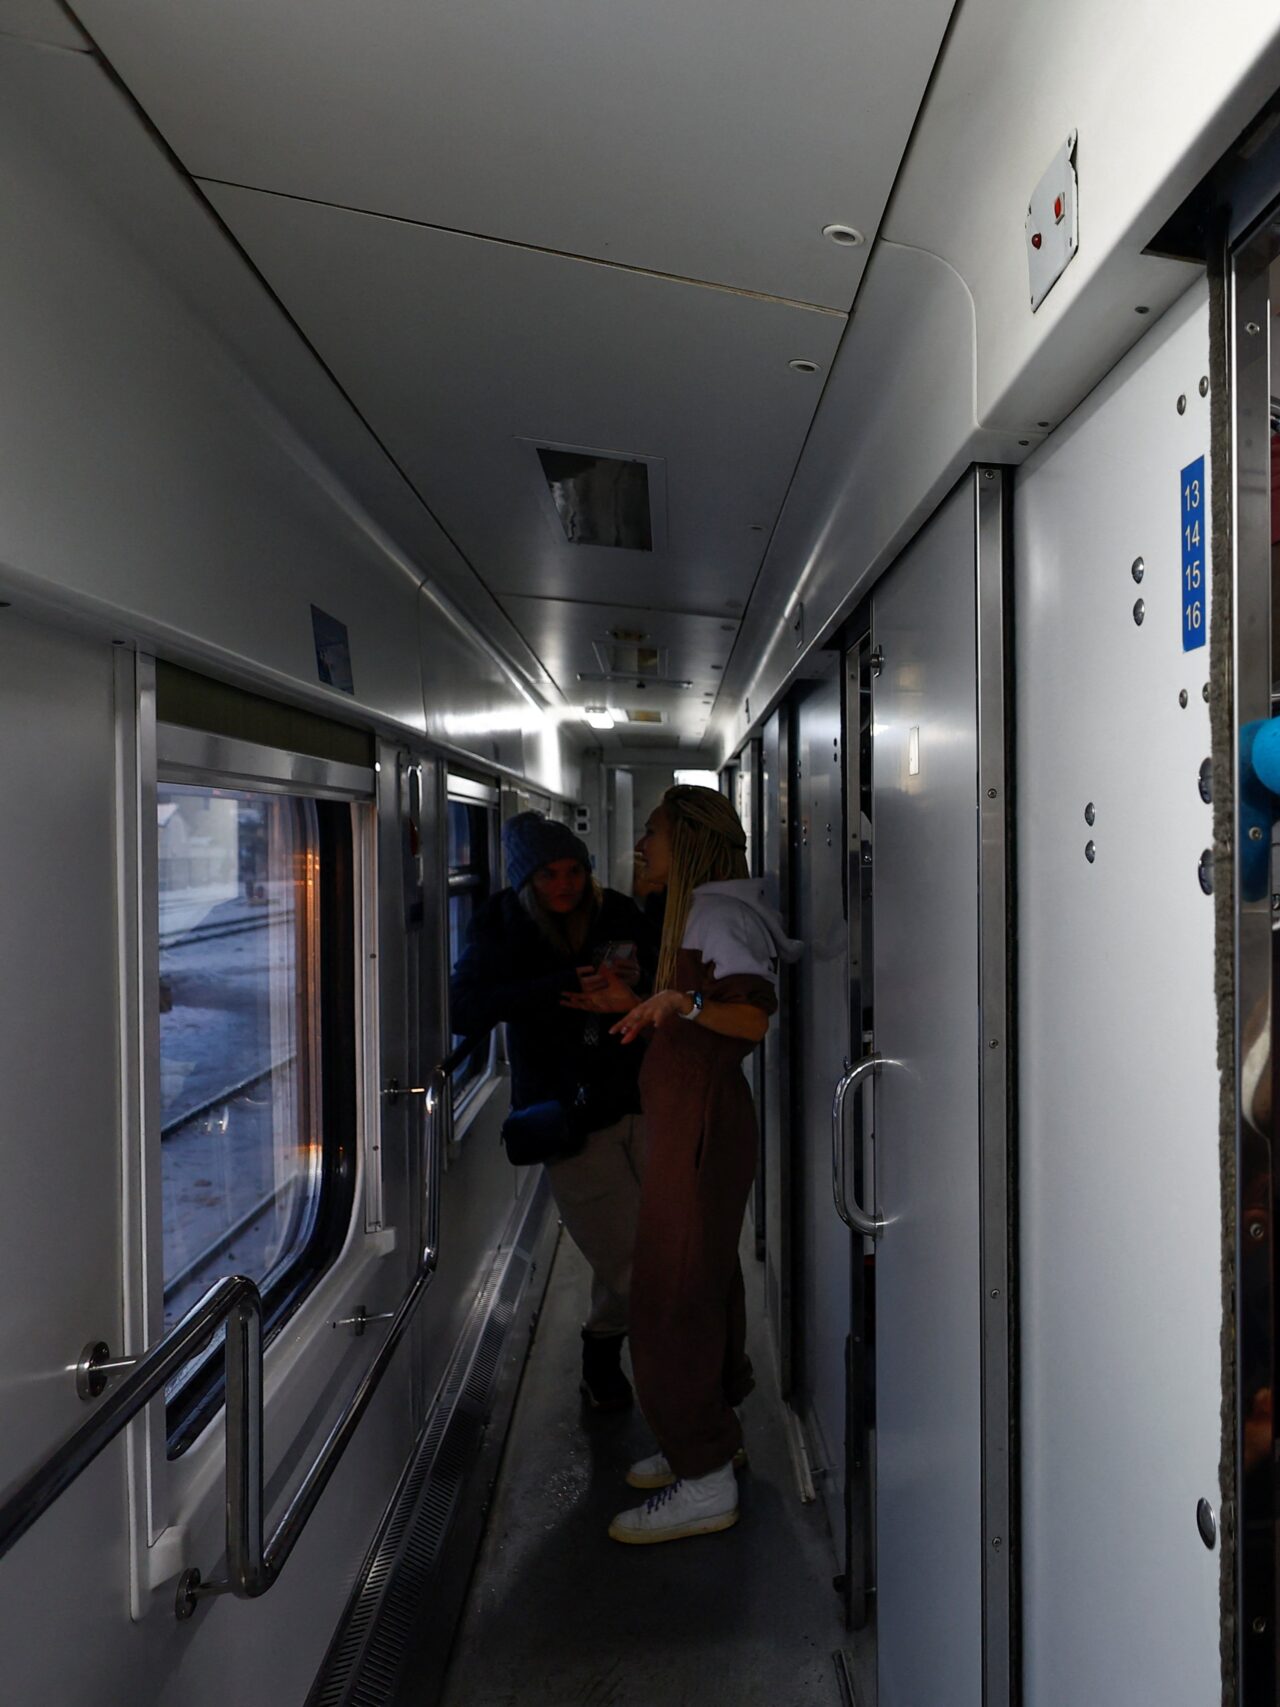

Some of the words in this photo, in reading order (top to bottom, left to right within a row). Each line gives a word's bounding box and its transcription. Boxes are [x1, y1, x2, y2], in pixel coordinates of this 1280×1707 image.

[1184, 479, 1200, 511] 13
[1185, 519, 1200, 551] 14
[1185, 560, 1200, 591] 15
[1186, 600, 1201, 631] 16
